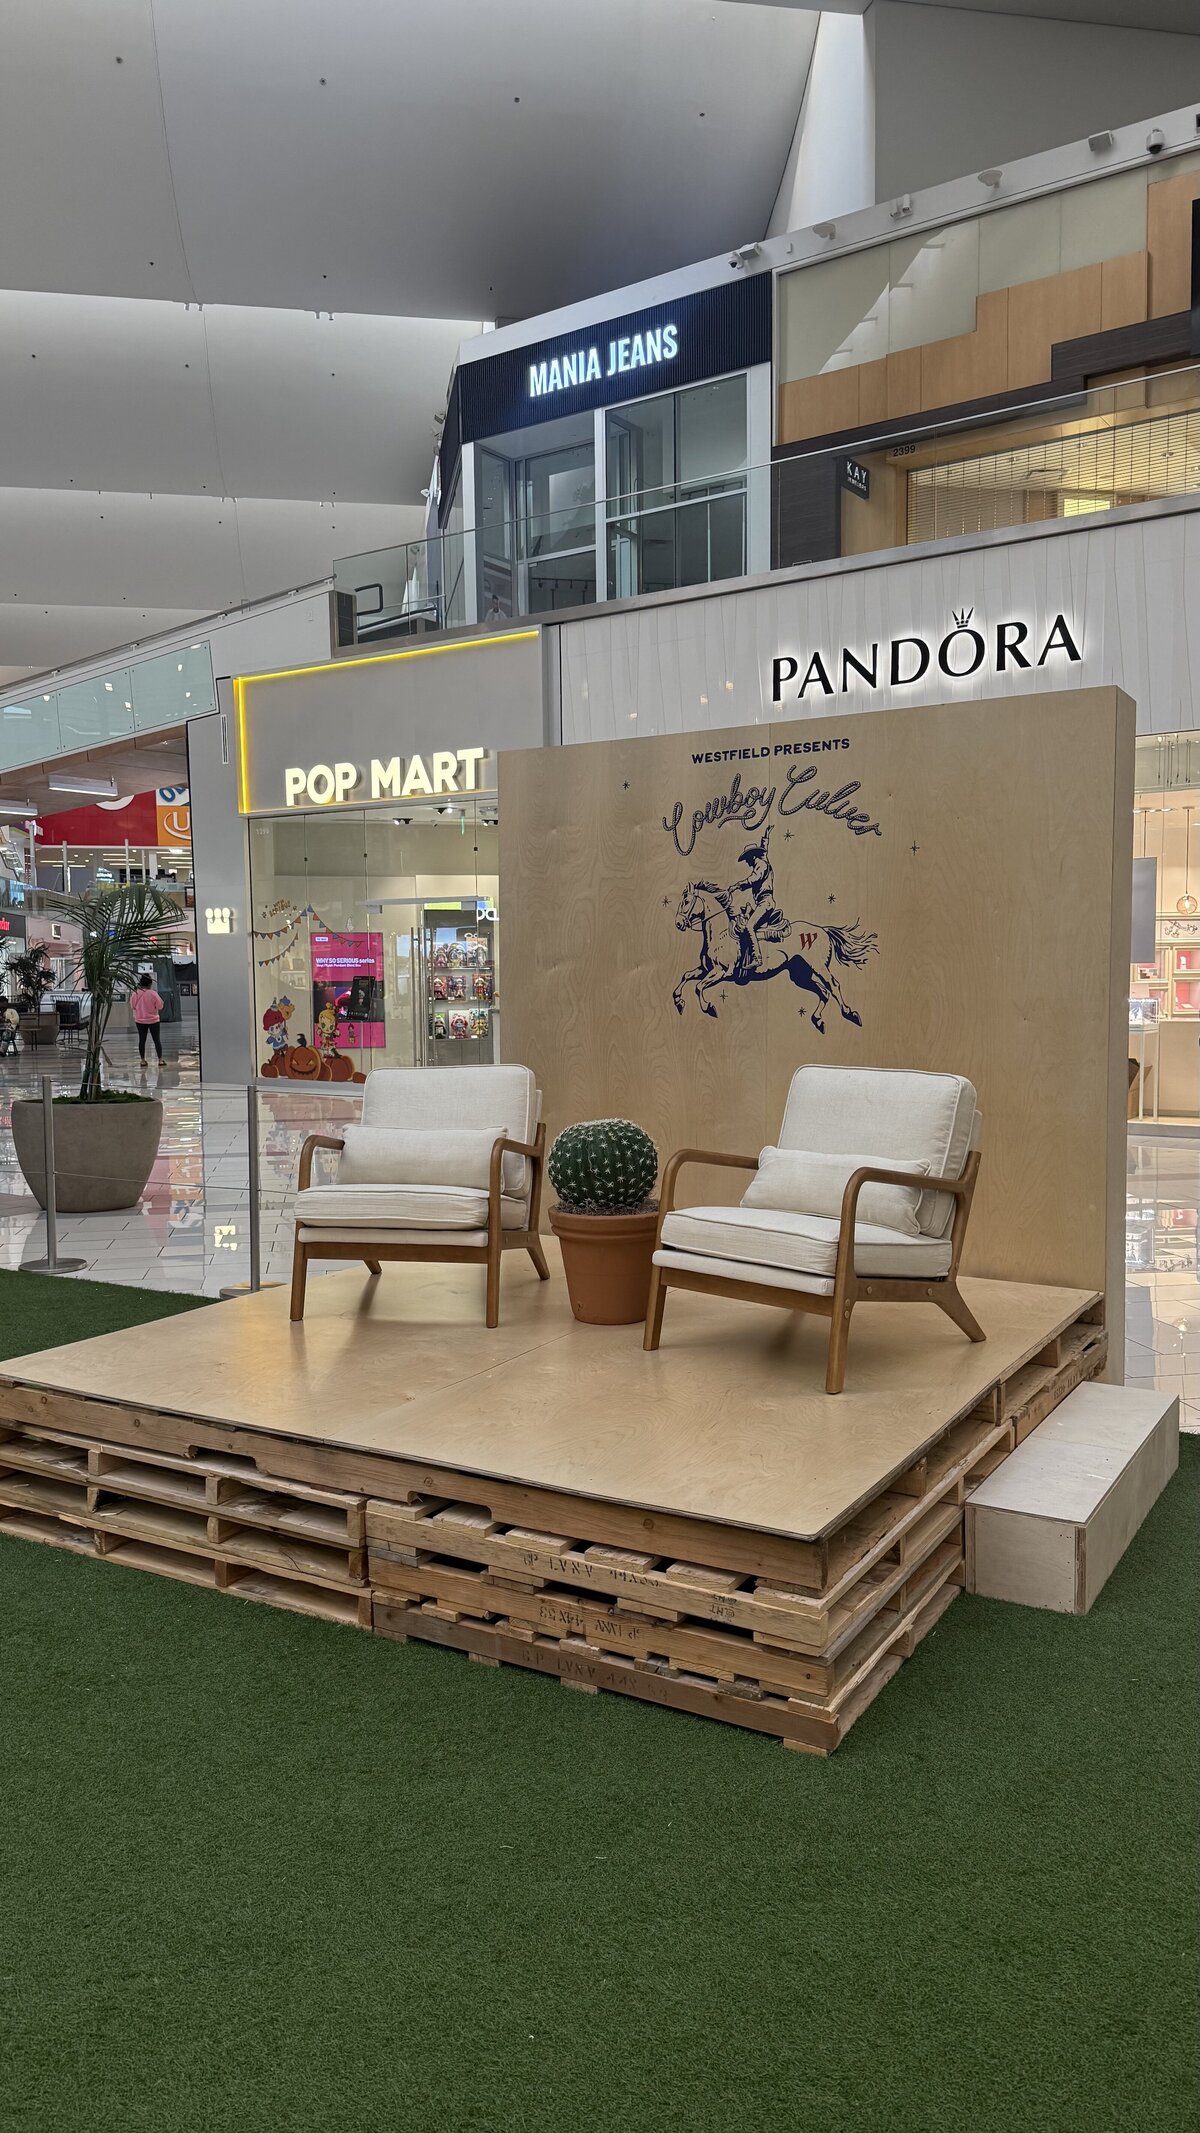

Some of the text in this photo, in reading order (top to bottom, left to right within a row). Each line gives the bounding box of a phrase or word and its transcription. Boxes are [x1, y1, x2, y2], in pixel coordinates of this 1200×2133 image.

[529, 324, 678, 398] MANIA JEANS
[846, 461, 866, 483] KAY
[893, 445, 916, 457] 2399
[772, 614, 1082, 702] PANDORA
[691, 738, 850, 764] WESTFIELD PRESENTS
[285, 747, 485, 807] POP MART
[662, 764, 882, 857] Cowboy Culver
[799, 932, 818, 951] W
